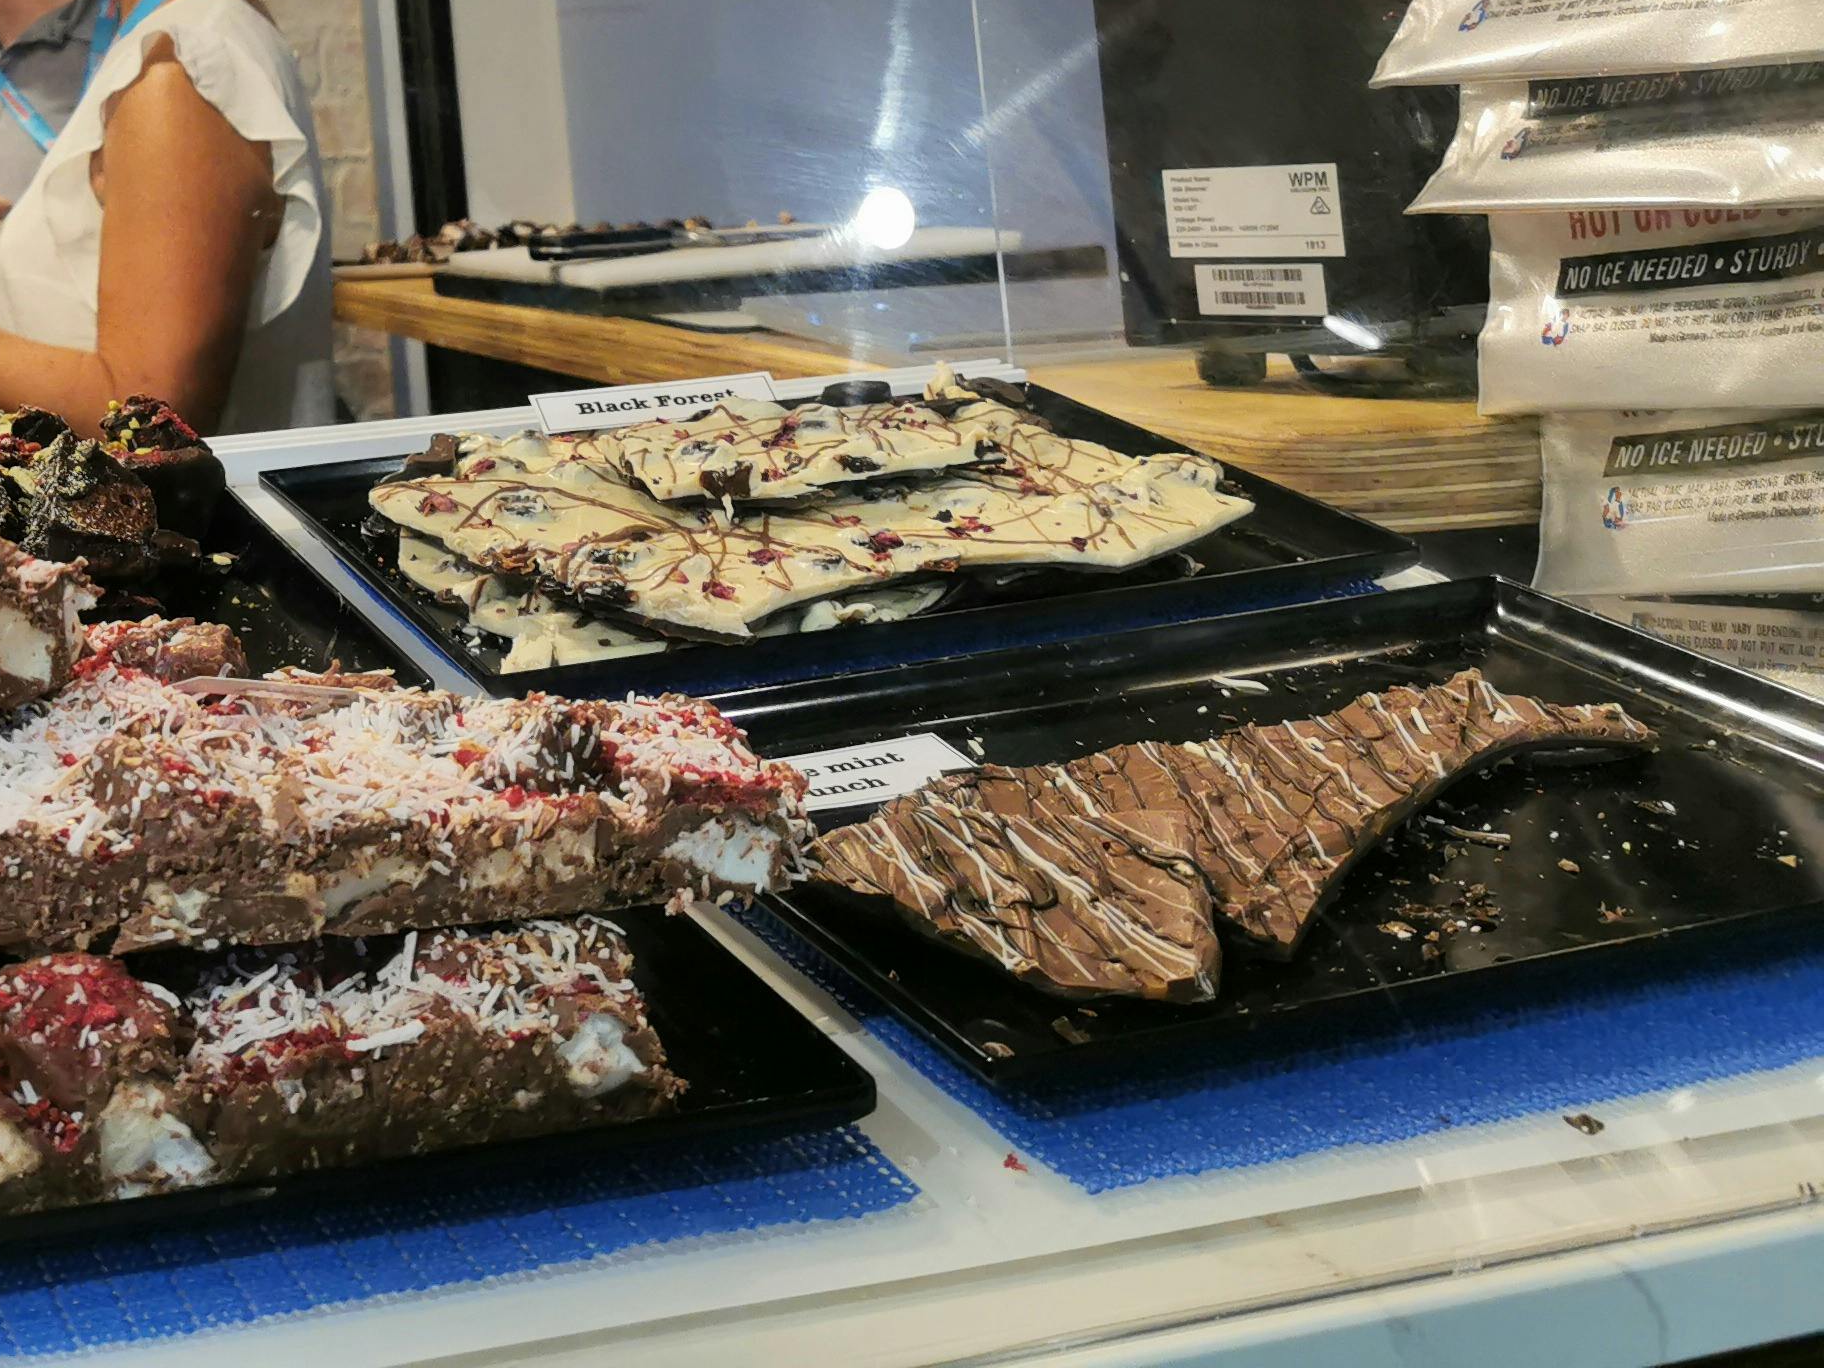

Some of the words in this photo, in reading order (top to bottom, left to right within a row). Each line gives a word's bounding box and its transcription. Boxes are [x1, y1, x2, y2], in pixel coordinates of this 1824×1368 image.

[1597, 75, 1674, 105] NEEDED
[1288, 171, 1328, 187] WPM
[1564, 266, 1591, 290] NO
[1595, 260, 1625, 287] ICE
[1627, 254, 1709, 282] NEEDED
[1729, 240, 1812, 274] STURDY
[576, 396, 651, 415] Black
[653, 388, 738, 408] Forest
[1614, 444, 1645, 468] NO
[1649, 439, 1684, 466] ICE
[1688, 432, 1767, 463] NEEDED
[825, 751, 905, 774] mint
[808, 777, 890, 797] unch
